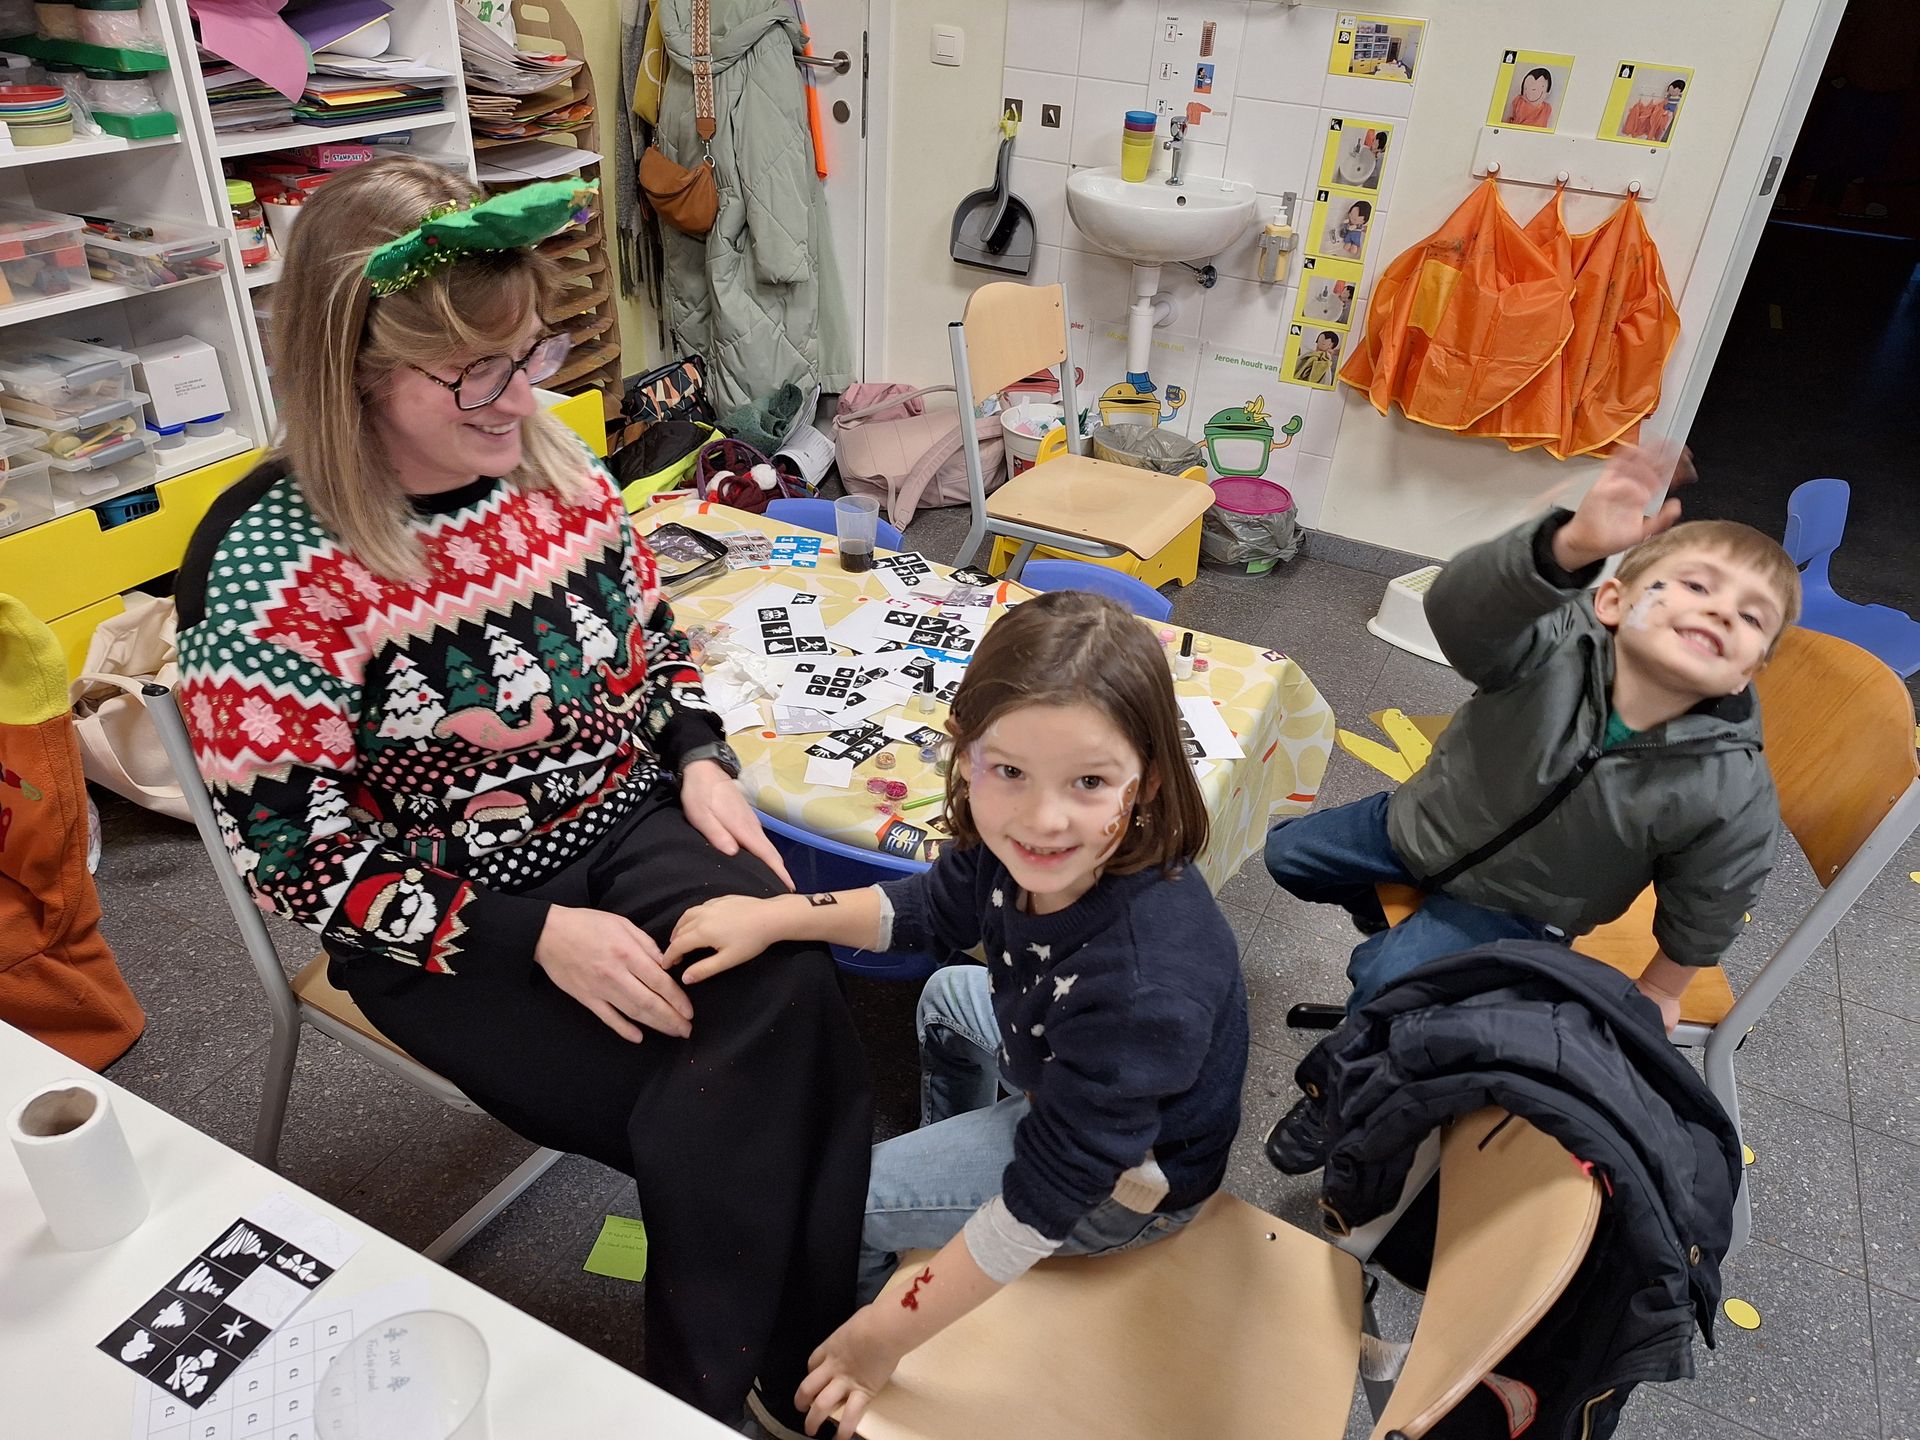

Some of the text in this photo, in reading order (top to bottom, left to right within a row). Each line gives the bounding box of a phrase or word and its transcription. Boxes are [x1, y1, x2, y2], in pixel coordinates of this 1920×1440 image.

[332, 153, 362, 161] STAMP SET
[1070, 321, 1084, 330] pier
[1215, 353, 1239, 364] Jeroen
[1240, 358, 1263, 369] houdt
[1264, 364, 1278, 372] van
[328, 1325, 338, 1336] €1
[289, 1337, 299, 1348] €1
[289, 1368, 299, 1379] €1
[248, 1380, 259, 1391] €1
[289, 1400, 299, 1412] €1
[165, 1406, 175, 1418] €1
[247, 1413, 257, 1425] €1
[205, 1426, 216, 1438] €1
